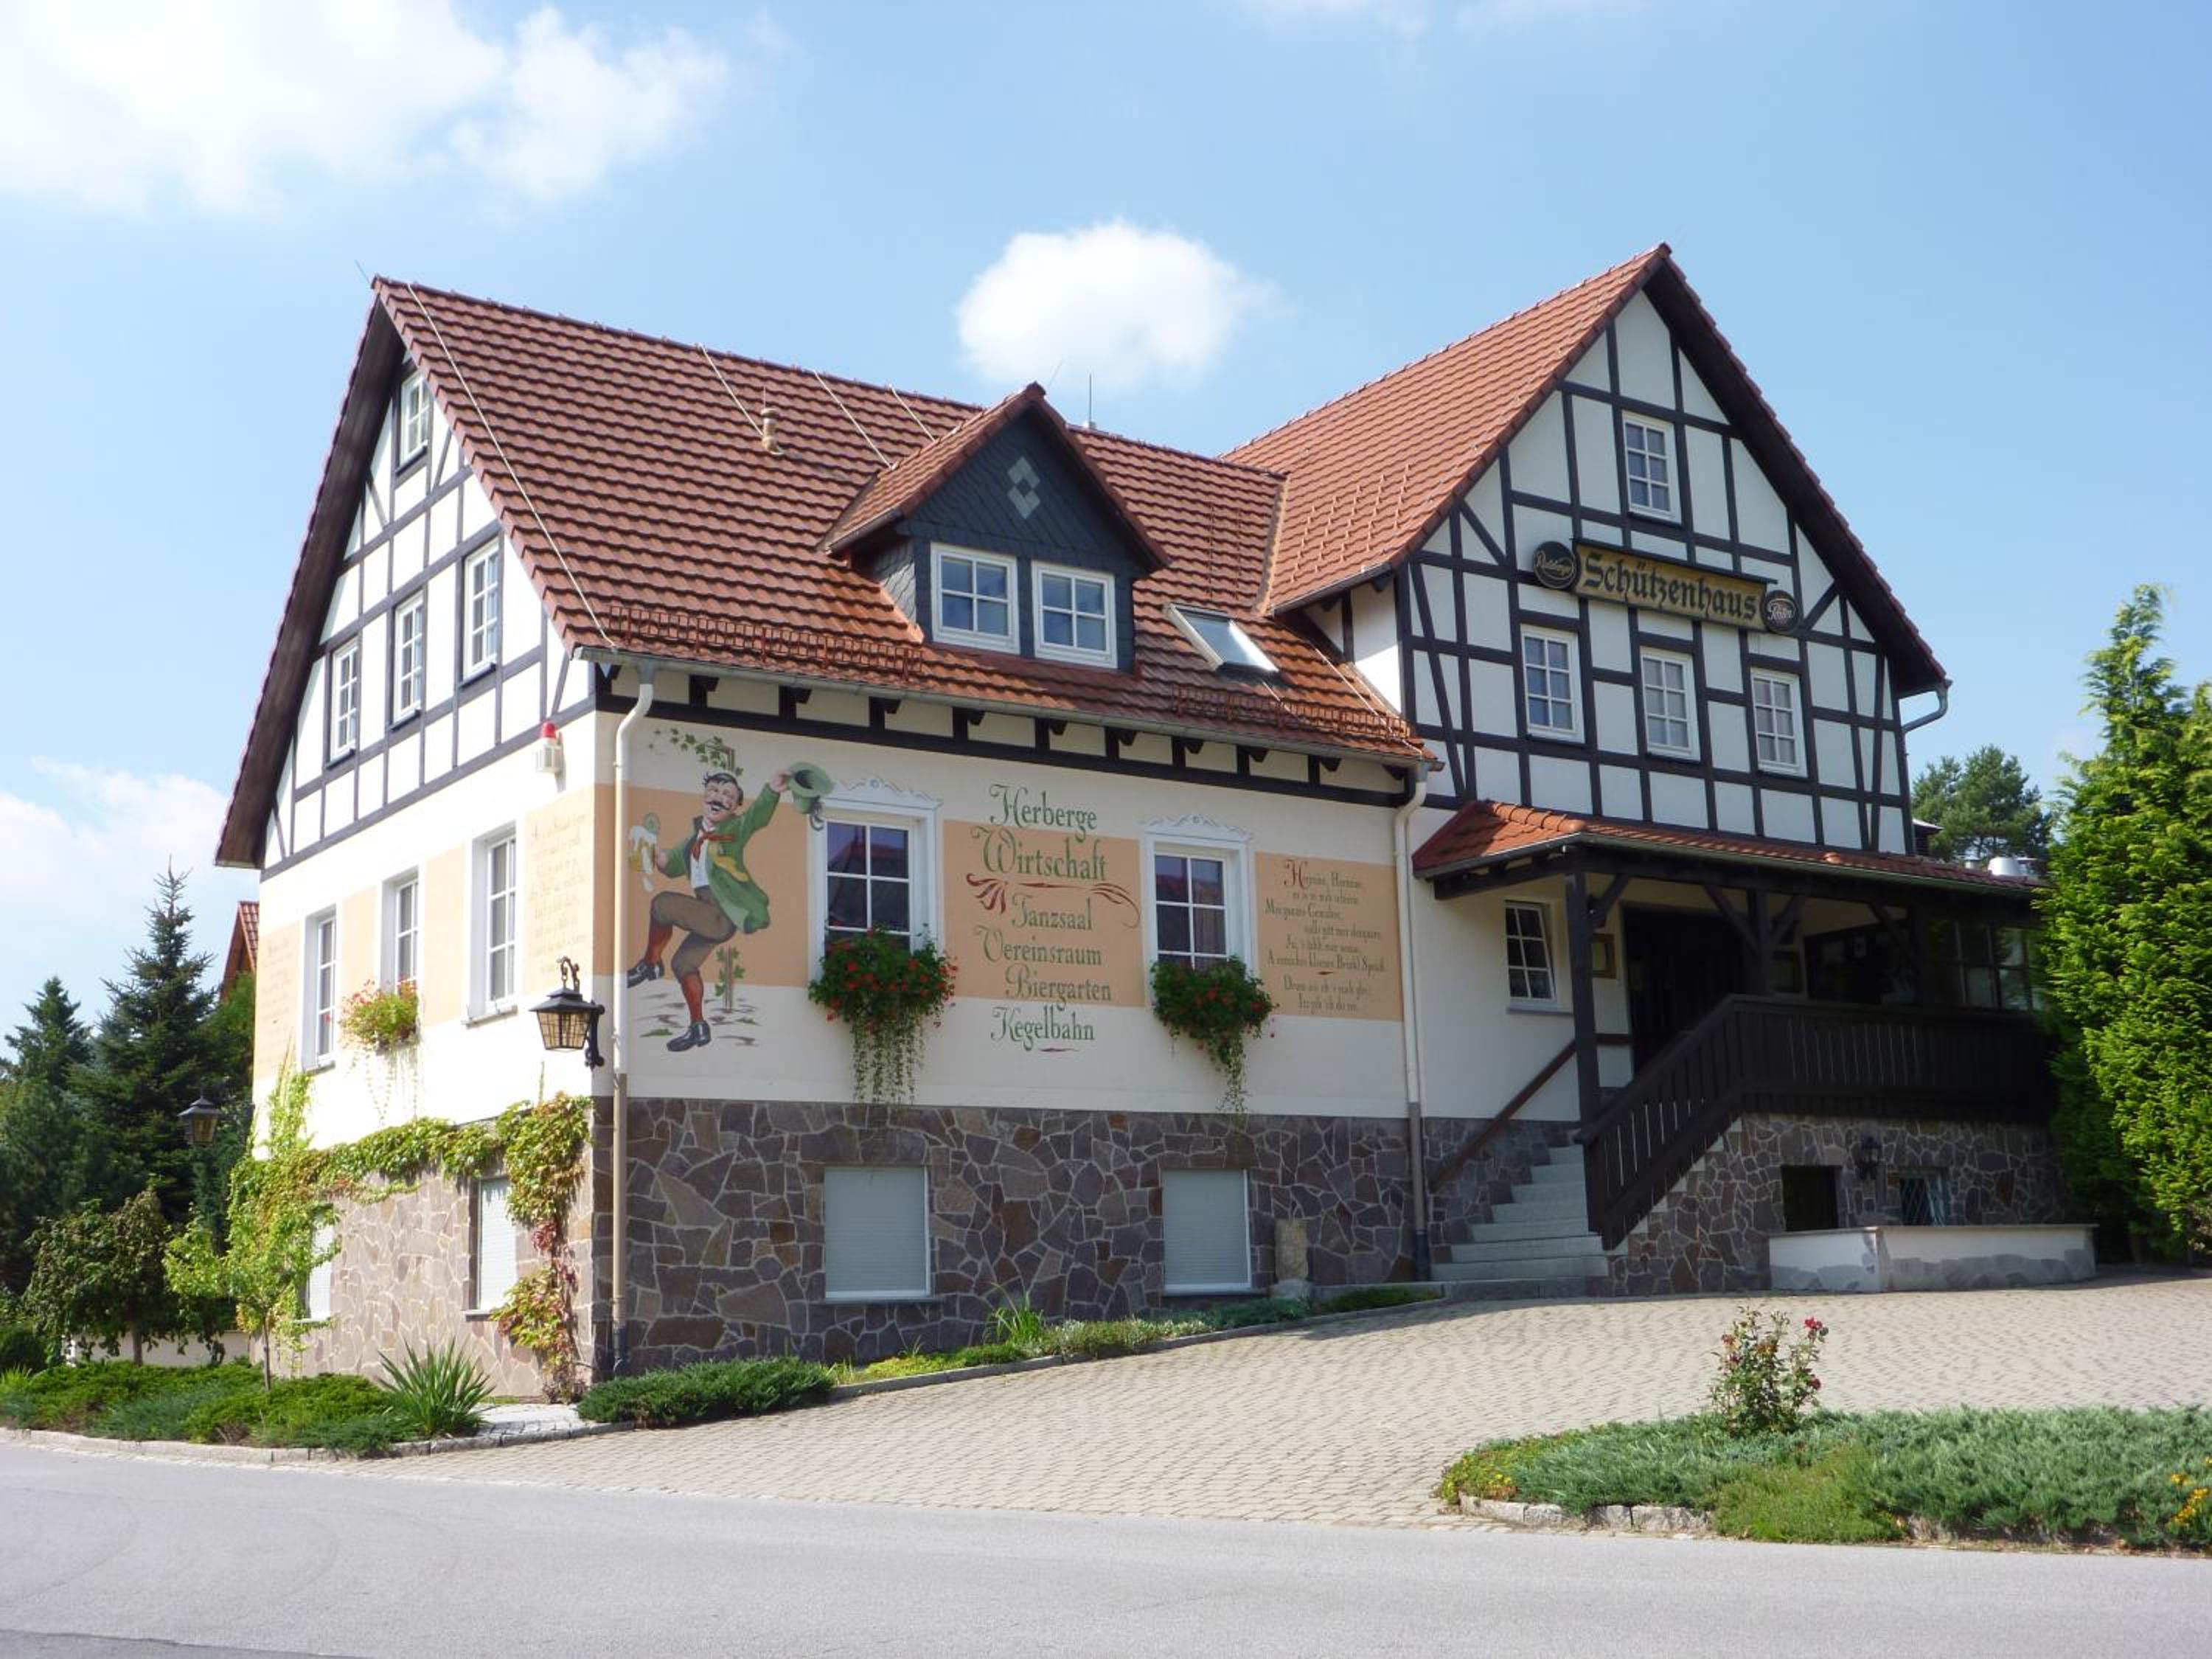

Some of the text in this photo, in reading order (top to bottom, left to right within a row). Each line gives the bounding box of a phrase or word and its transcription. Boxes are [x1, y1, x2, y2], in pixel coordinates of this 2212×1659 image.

[1585, 554, 1756, 620] Schützenhaus
[989, 784, 1098, 843] Herberge
[970, 825, 1107, 882] Wirtschaft
[1011, 892, 1093, 931] Tanzsaal
[975, 925, 1102, 965] Vereinsraum
[1004, 963, 1112, 1010] Biergarten
[990, 1005, 1095, 1051] Kegelbahn
